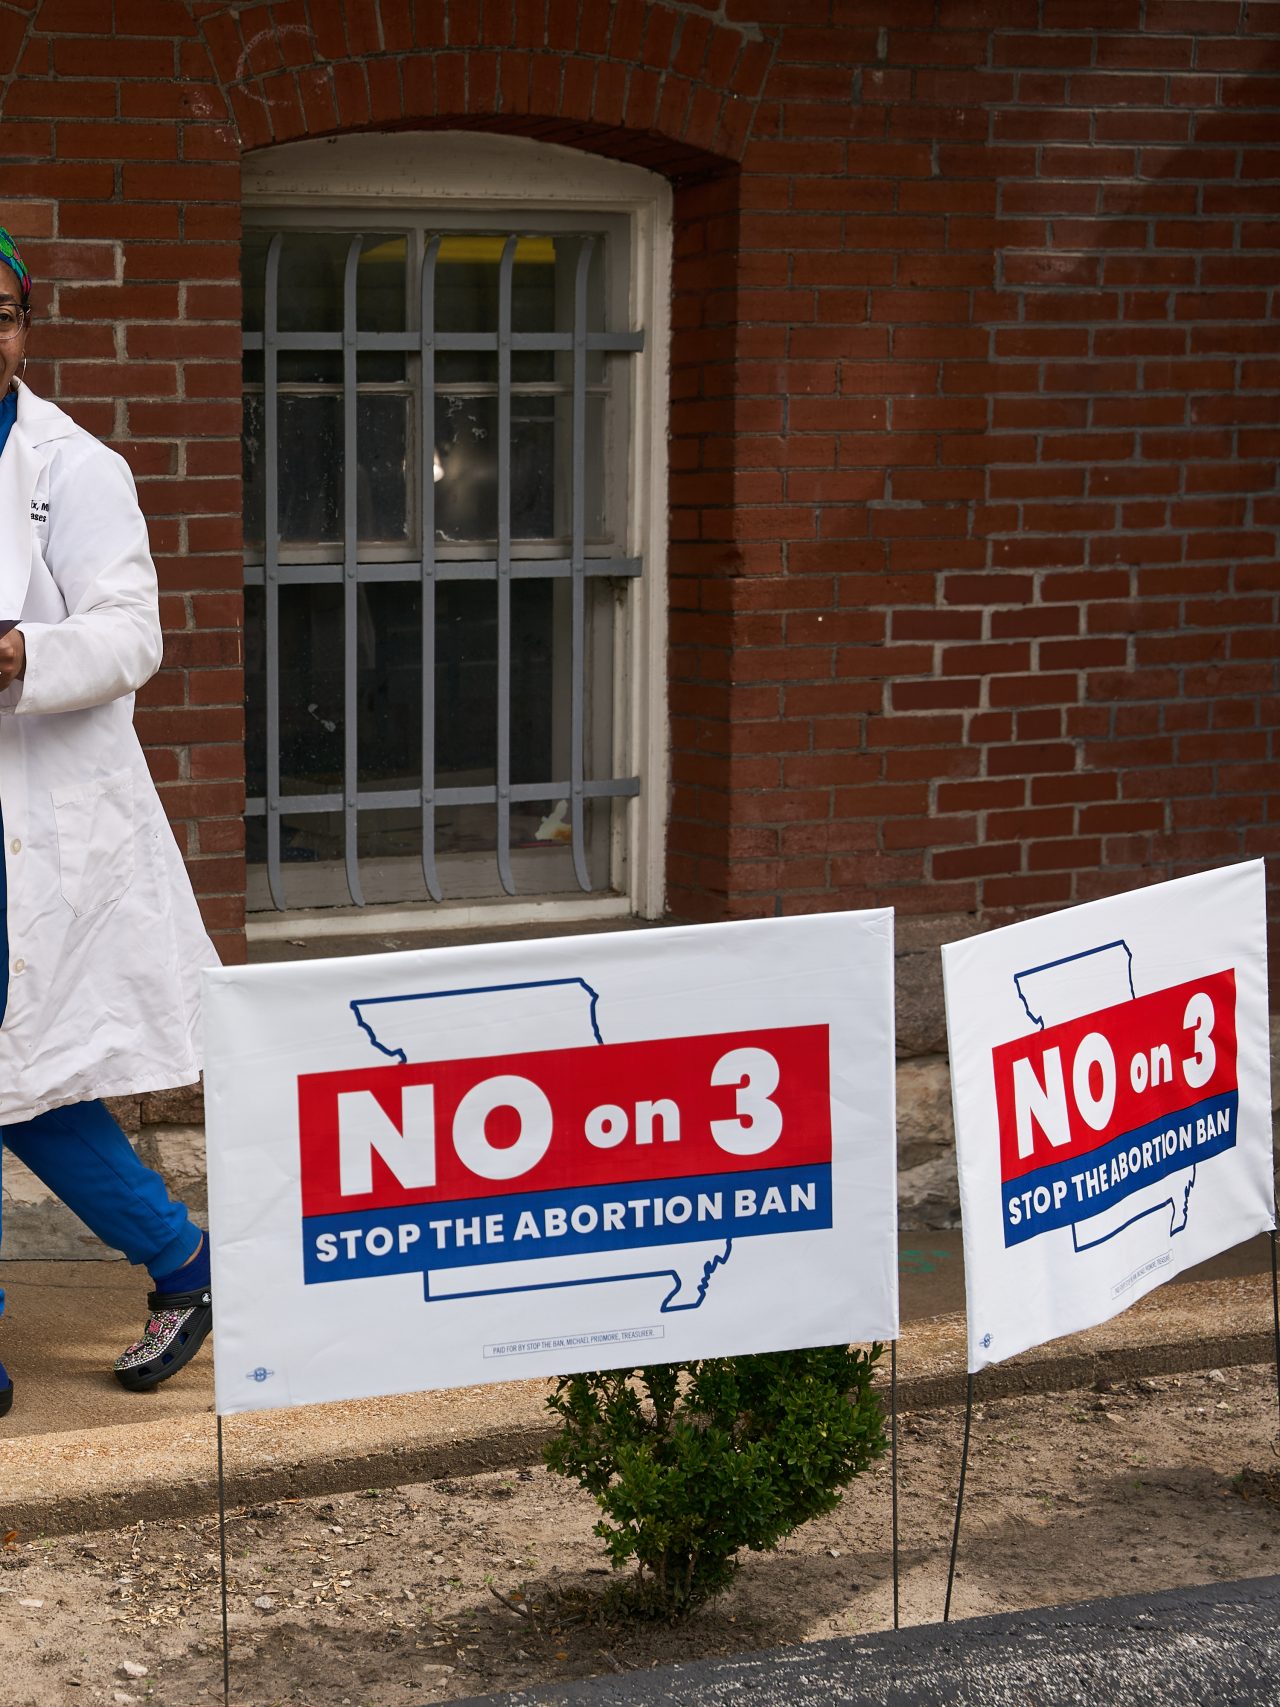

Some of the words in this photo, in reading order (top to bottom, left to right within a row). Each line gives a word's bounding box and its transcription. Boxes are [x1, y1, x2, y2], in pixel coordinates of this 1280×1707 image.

[30, 513, 47, 523] ases
[336, 1074, 554, 1197] NO
[584, 1098, 681, 1150] on
[709, 1047, 783, 1155] 3
[1012, 1031, 1117, 1161] NO
[1129, 1042, 1173, 1095] on
[1182, 991, 1217, 1089] 3
[1008, 1179, 1067, 1227] STOP
[1071, 1164, 1110, 1202] THE
[1109, 1124, 1193, 1184] ABORTION
[1196, 1107, 1231, 1147] BAN
[315, 1224, 421, 1263] STOP
[428, 1213, 505, 1251] THE
[513, 1191, 723, 1240] ABORTION
[734, 1182, 817, 1218] BAN
[506, 1345, 517, 1353] FOR
[526, 1343, 541, 1351] STOP
[541, 1341, 552, 1349] THE
[566, 1336, 589, 1345] MICHAEL
